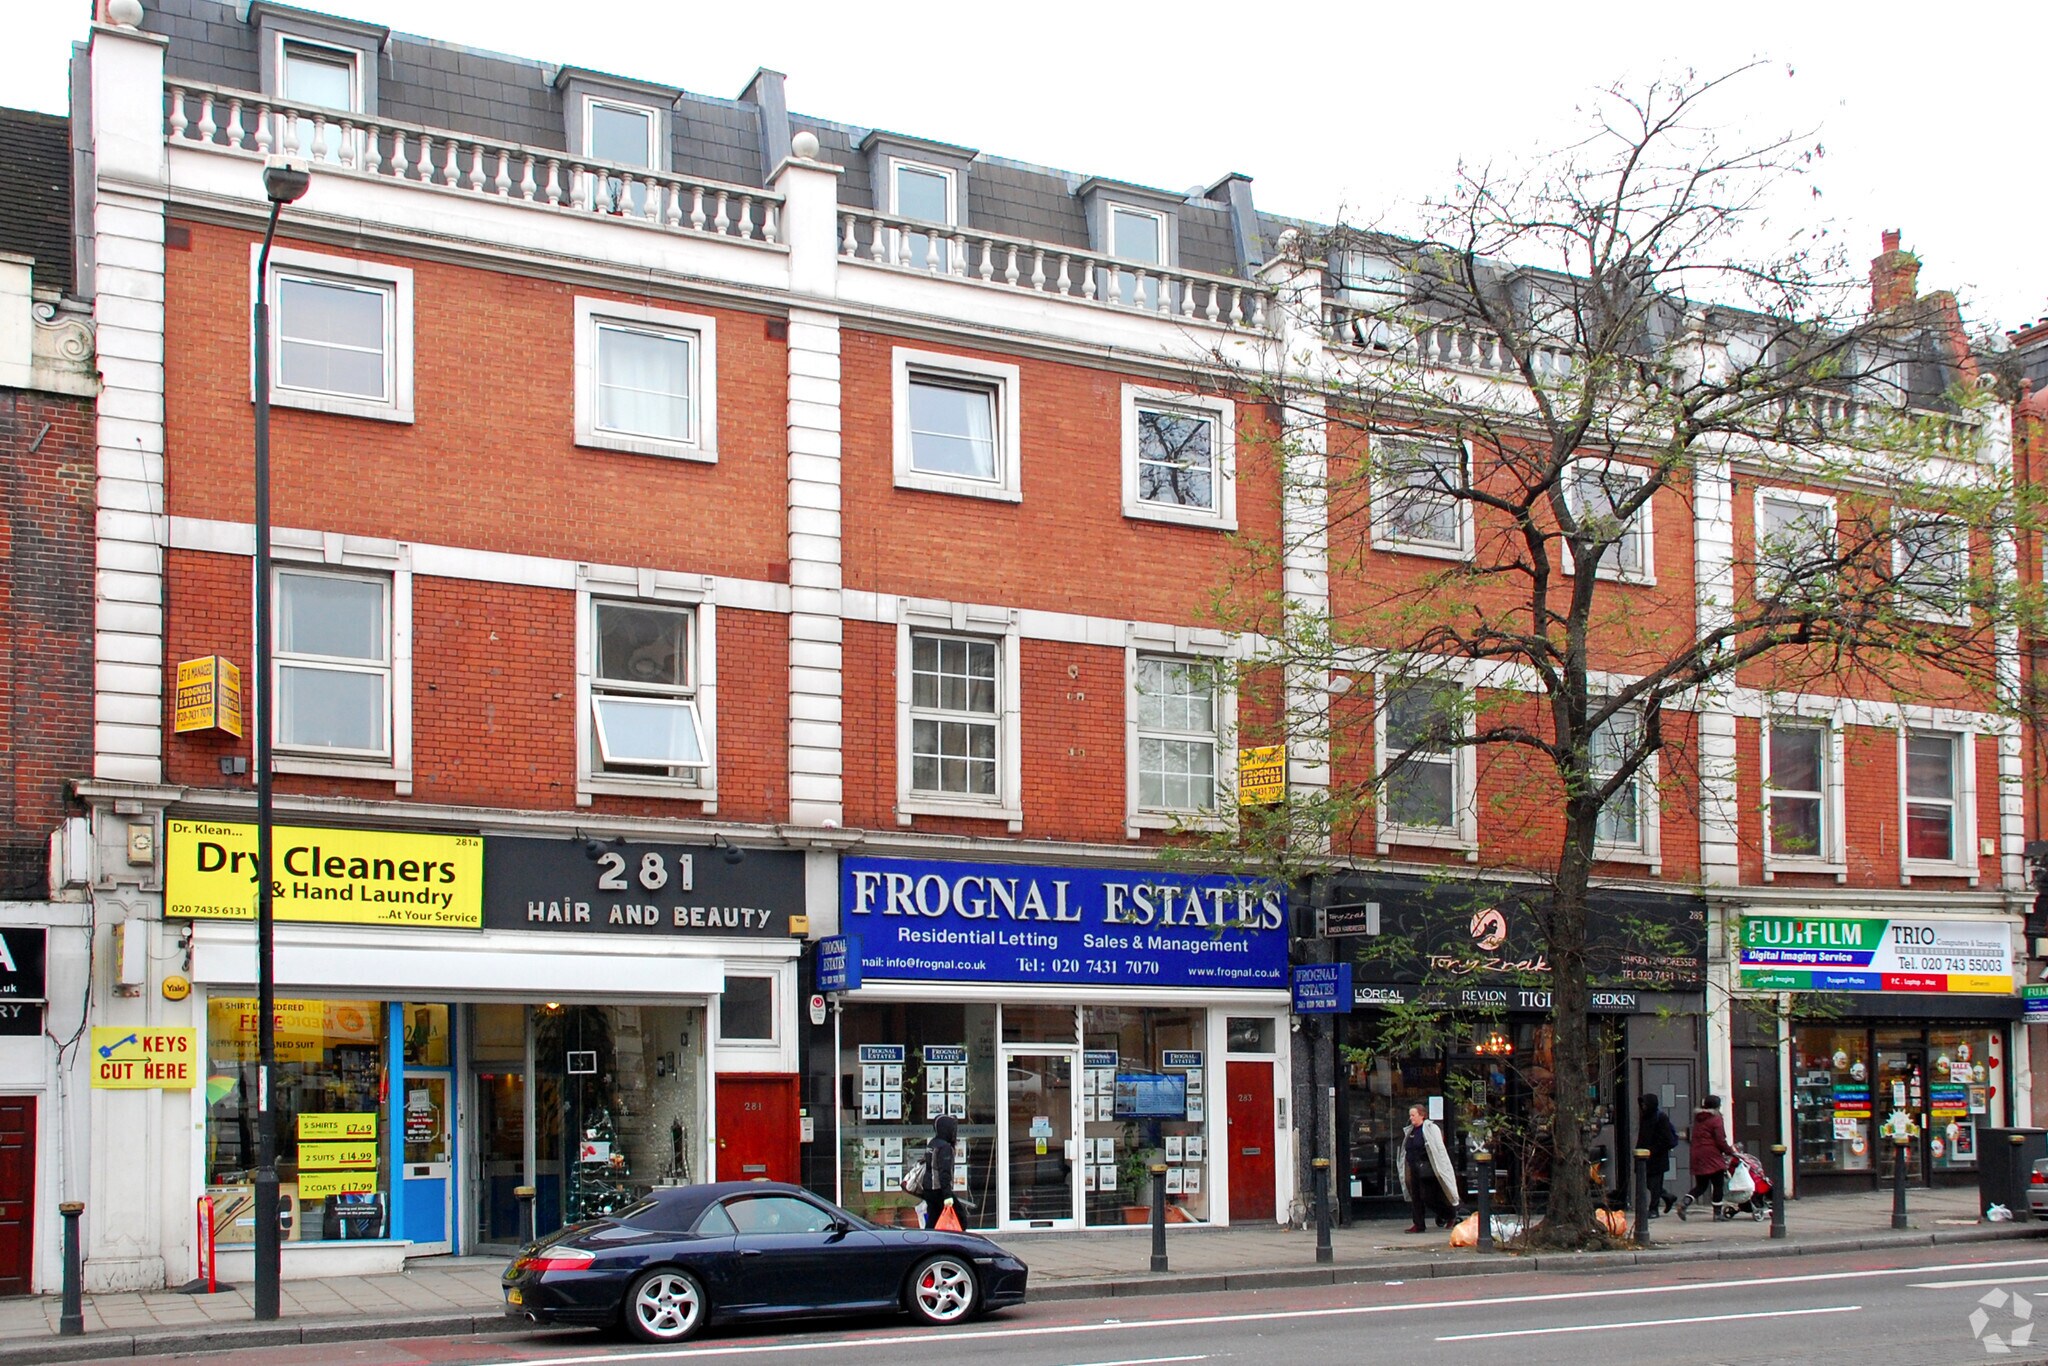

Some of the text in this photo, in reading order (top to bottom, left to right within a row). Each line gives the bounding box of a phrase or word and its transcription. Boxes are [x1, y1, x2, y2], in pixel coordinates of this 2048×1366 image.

[179, 685, 211, 699] FROGNAL
[179, 694, 211, 708] ESTATES
[1242, 767, 1281, 778] FROGNAL
[1242, 775, 1281, 787] ESTATES
[172, 823, 243, 837] Dr. Klean...
[456, 838, 479, 847] 281a
[197, 842, 457, 884] Dry Cleaners
[597, 852, 695, 891] 281
[271, 881, 453, 910] & Hand Laundry
[851, 871, 1284, 930] FROGNAL ESTATES
[172, 904, 247, 916] 020 7435 6131
[1688, 910, 1704, 920] 285
[404, 911, 430, 922] Your
[435, 912, 478, 923] Service
[609, 904, 660, 926] AND
[674, 906, 772, 930] BEAUTY
[897, 927, 1249, 955] Residential Letting Sales & Management
[1891, 926, 1935, 945] TRIO
[1935, 938, 1970, 947] Computers
[1976, 940, 2001, 948] Imaging
[862, 956, 987, 971] mail: info@frognal.co.uk
[1749, 951, 1853, 963] Digital Imaging Service
[1052, 958, 1080, 974] 020
[1086, 960, 1118, 975] 7431
[1125, 960, 1160, 975] 7070
[1898, 956, 2003, 972] Tel. 020 743 55003
[1188, 966, 1281, 979] www.frognal.co.uk
[1295, 968, 1338, 983] FROGNAL
[166, 982, 186, 993] Yale
[1299, 983, 1335, 997] ESTATES
[1462, 990, 1507, 1001] REVLON
[1518, 991, 1552, 1007] TIGI
[1592, 993, 1636, 1006] REDKEN
[0, 1005, 22, 1018] RY
[225, 1003, 251, 1011] SHIRT
[240, 1014, 284, 1029] FRE
[143, 1035, 188, 1054] KEYS
[296, 1041, 315, 1049] SUIT
[100, 1063, 188, 1080] CUT HERE
[744, 1102, 763, 1111] 281
[346, 1124, 372, 1132] £7.49
[340, 1152, 372, 1160] £14.99
[341, 1182, 373, 1191] £17.99
